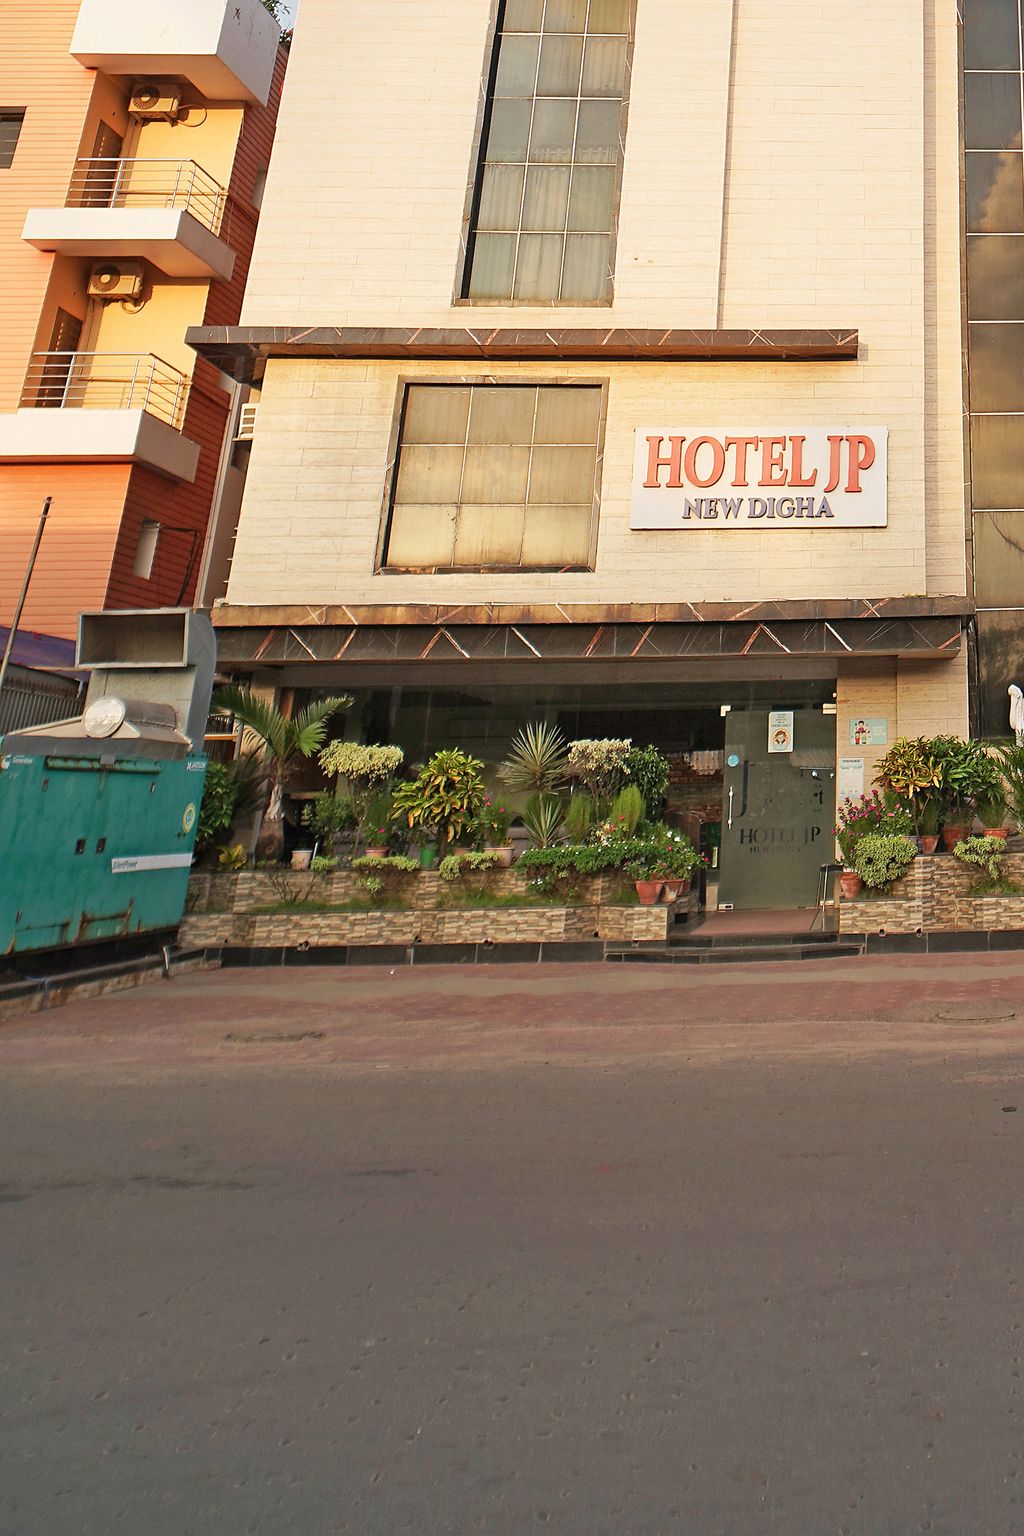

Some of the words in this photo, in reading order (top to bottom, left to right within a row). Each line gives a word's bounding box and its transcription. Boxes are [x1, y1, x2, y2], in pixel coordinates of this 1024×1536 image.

[643, 435, 817, 488] HOTEL
[824, 435, 876, 493] JP
[682, 497, 743, 519] NEW
[747, 496, 834, 519] DIGHA
[739, 828, 797, 845] HOTEL
[803, 826, 821, 845] JP
